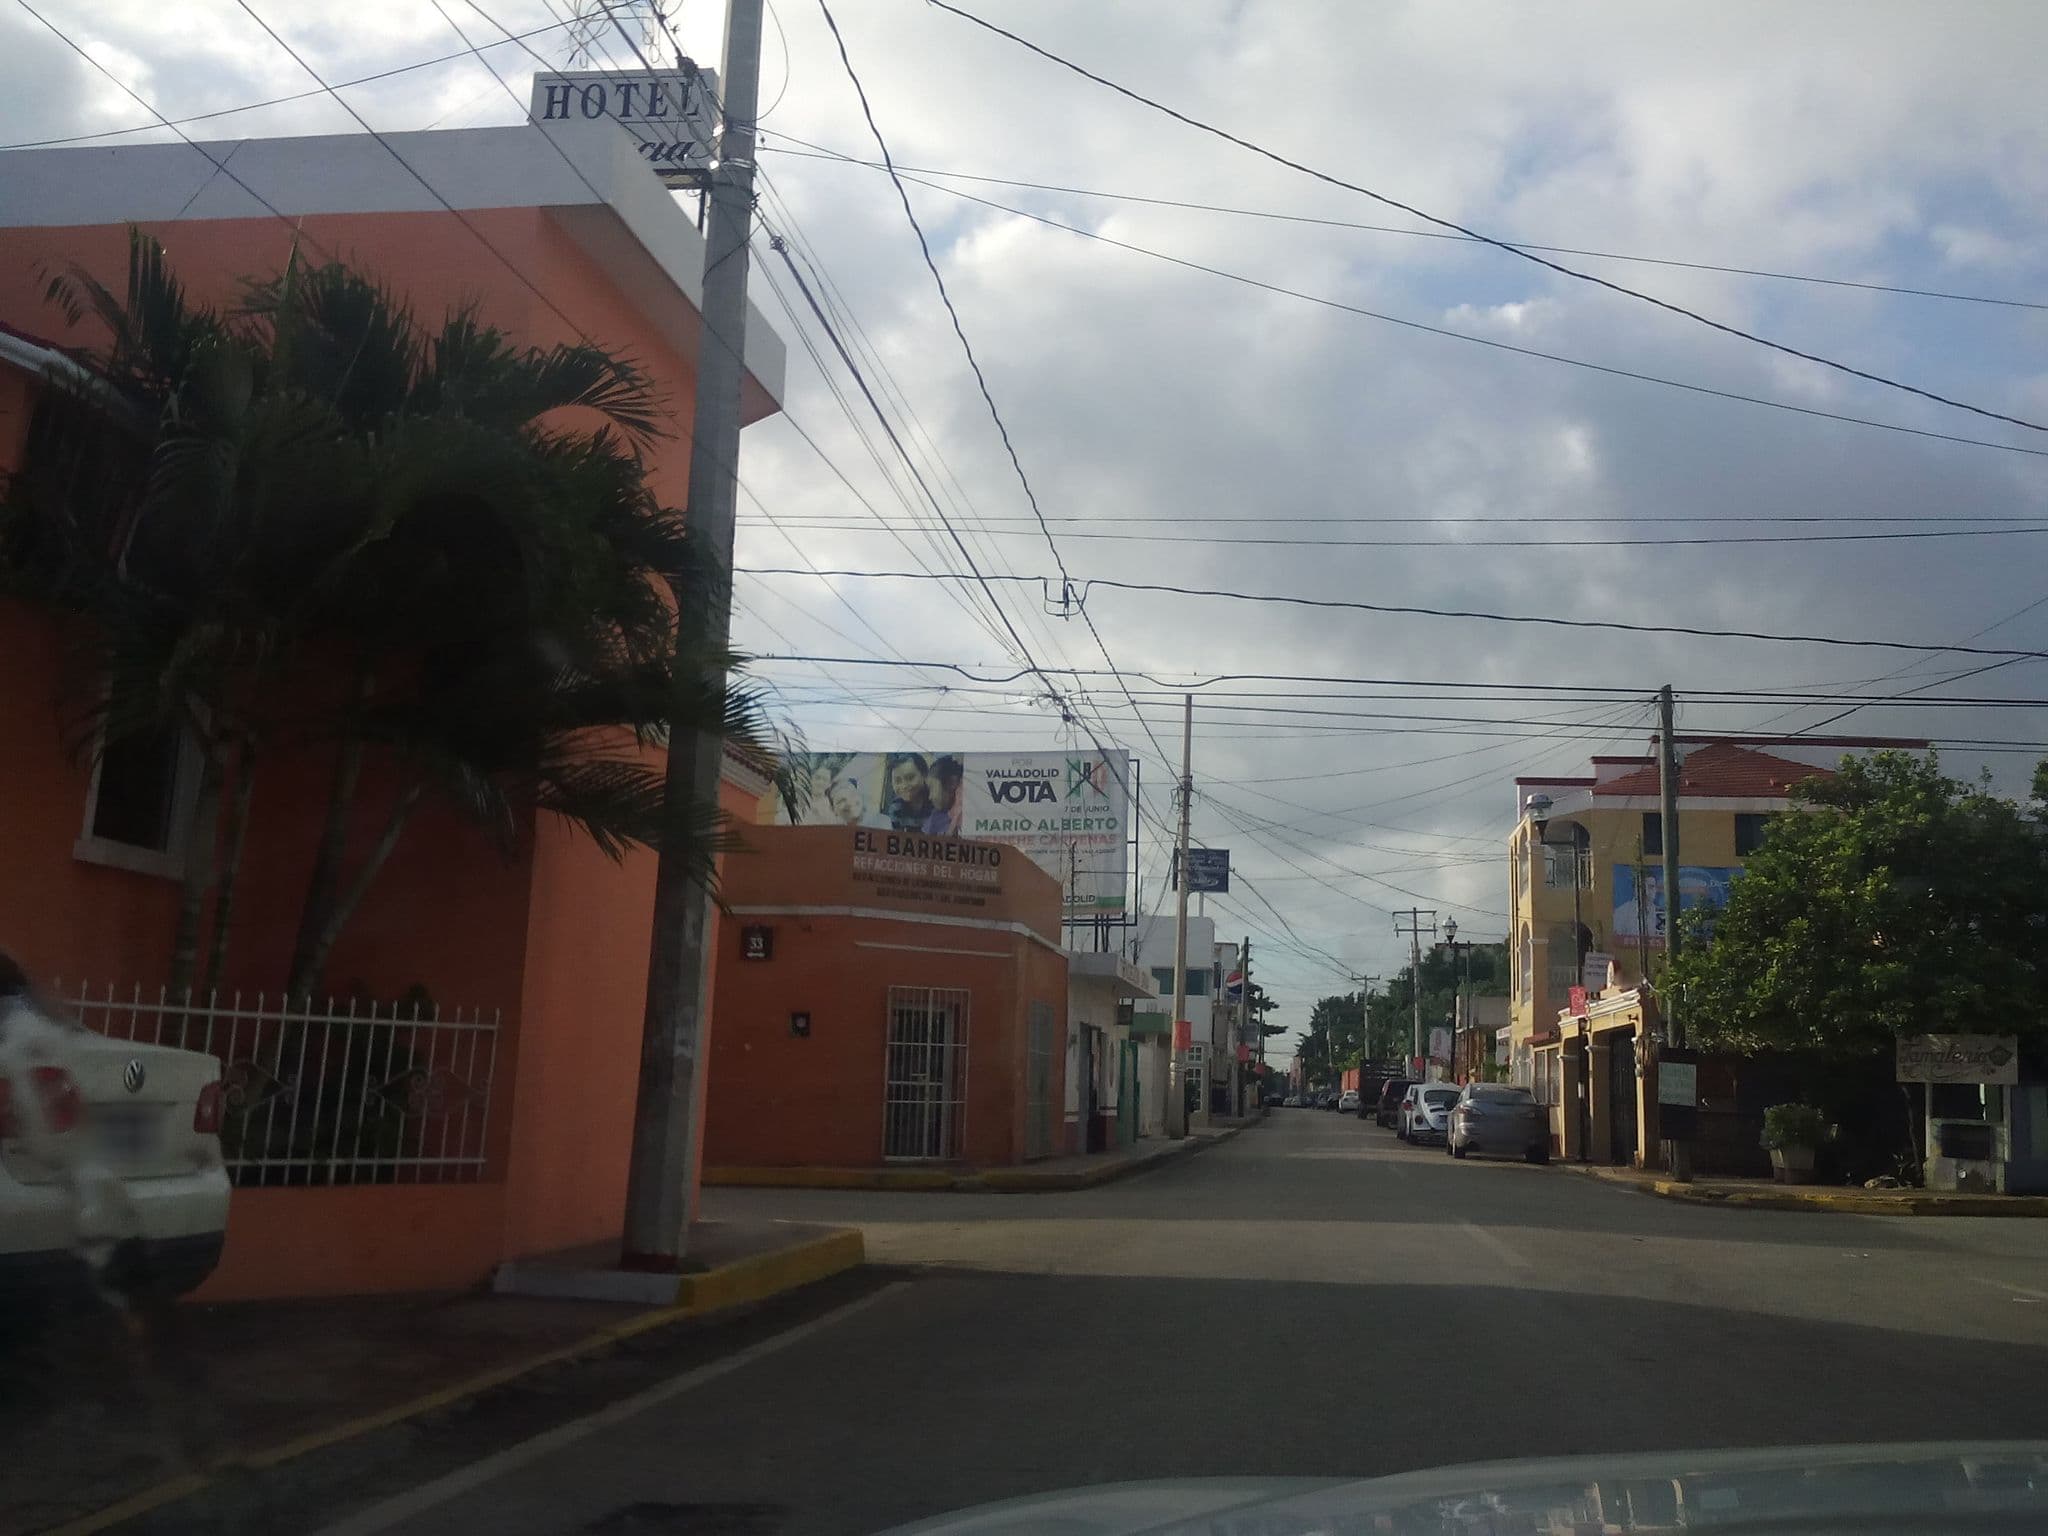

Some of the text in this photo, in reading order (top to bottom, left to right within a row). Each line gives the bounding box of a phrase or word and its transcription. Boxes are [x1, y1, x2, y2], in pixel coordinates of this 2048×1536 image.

[543, 82, 702, 120] HOTEL
[986, 769, 1059, 778] VALLADOLID
[987, 780, 1057, 803] VOTA
[975, 818, 1118, 831] MARIO ALBERTO
[854, 831, 1001, 867] EL BARRENITO
[853, 856, 928, 875] REFACCIONES
[933, 866, 955, 878] DEL
